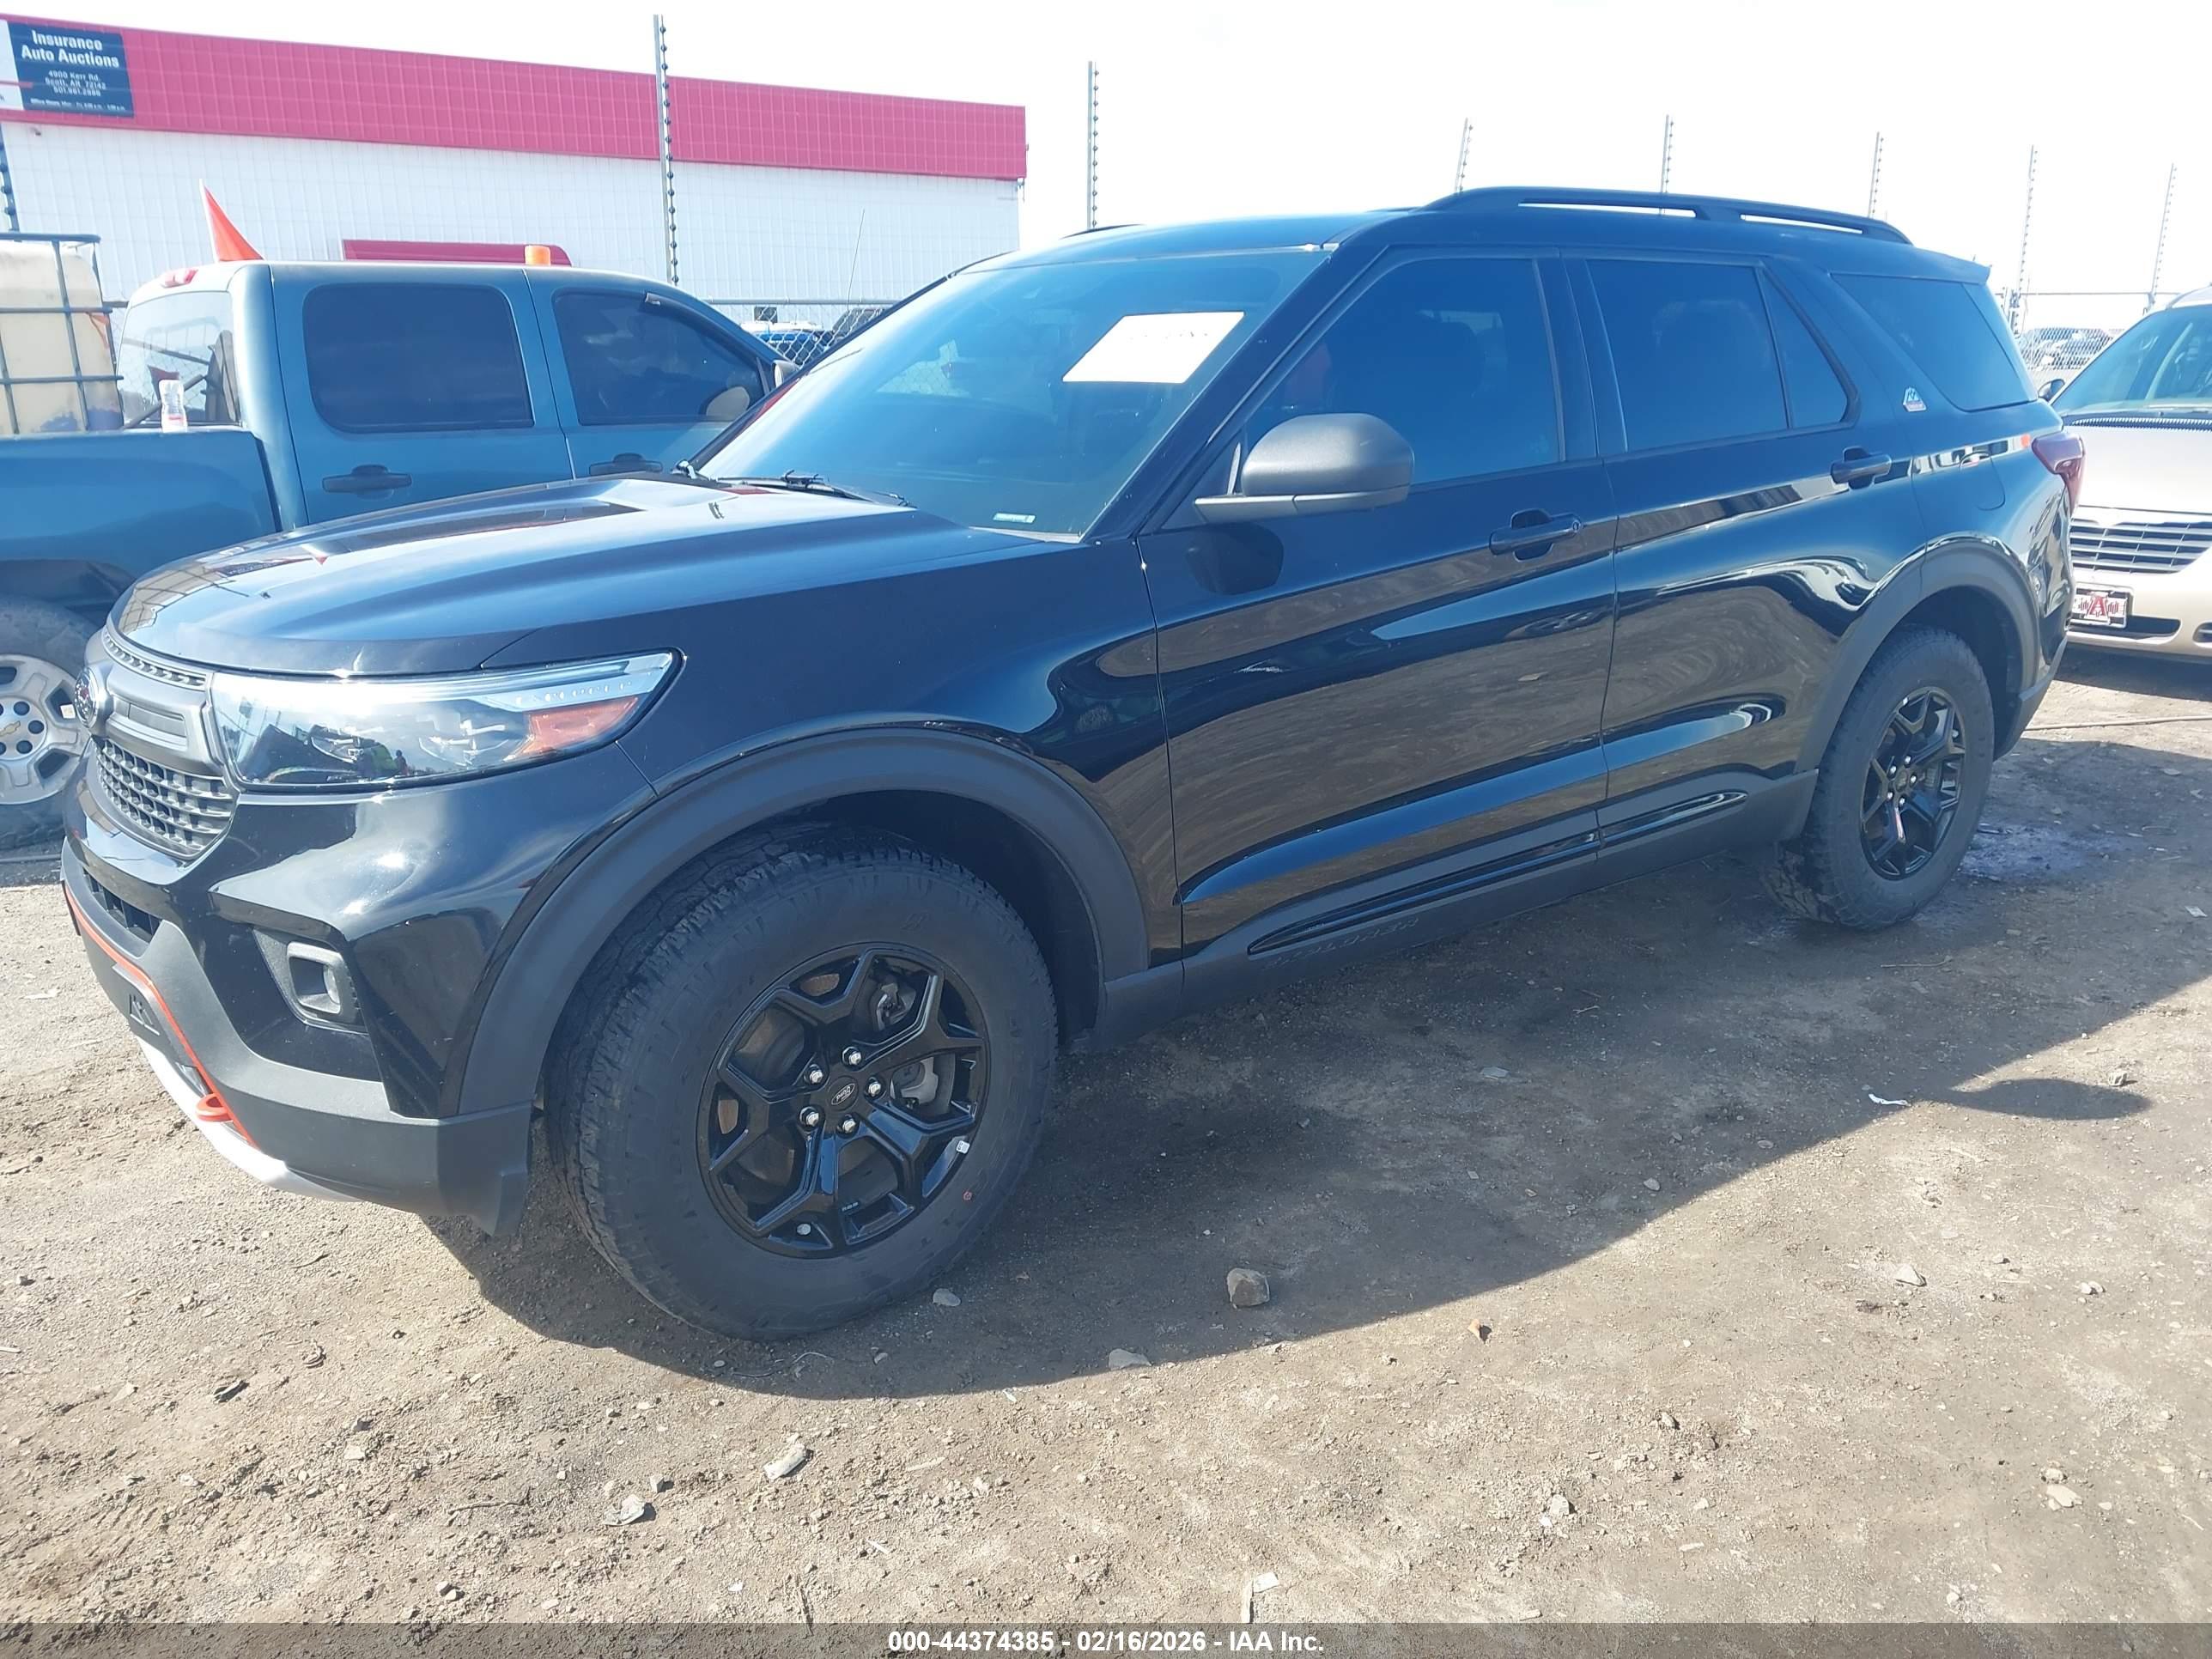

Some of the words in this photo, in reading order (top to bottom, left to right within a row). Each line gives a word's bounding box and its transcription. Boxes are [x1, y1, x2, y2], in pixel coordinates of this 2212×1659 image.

[31, 30, 102, 50] Insurance
[21, 45, 54, 62] Auto
[58, 49, 119, 68] Auctions
